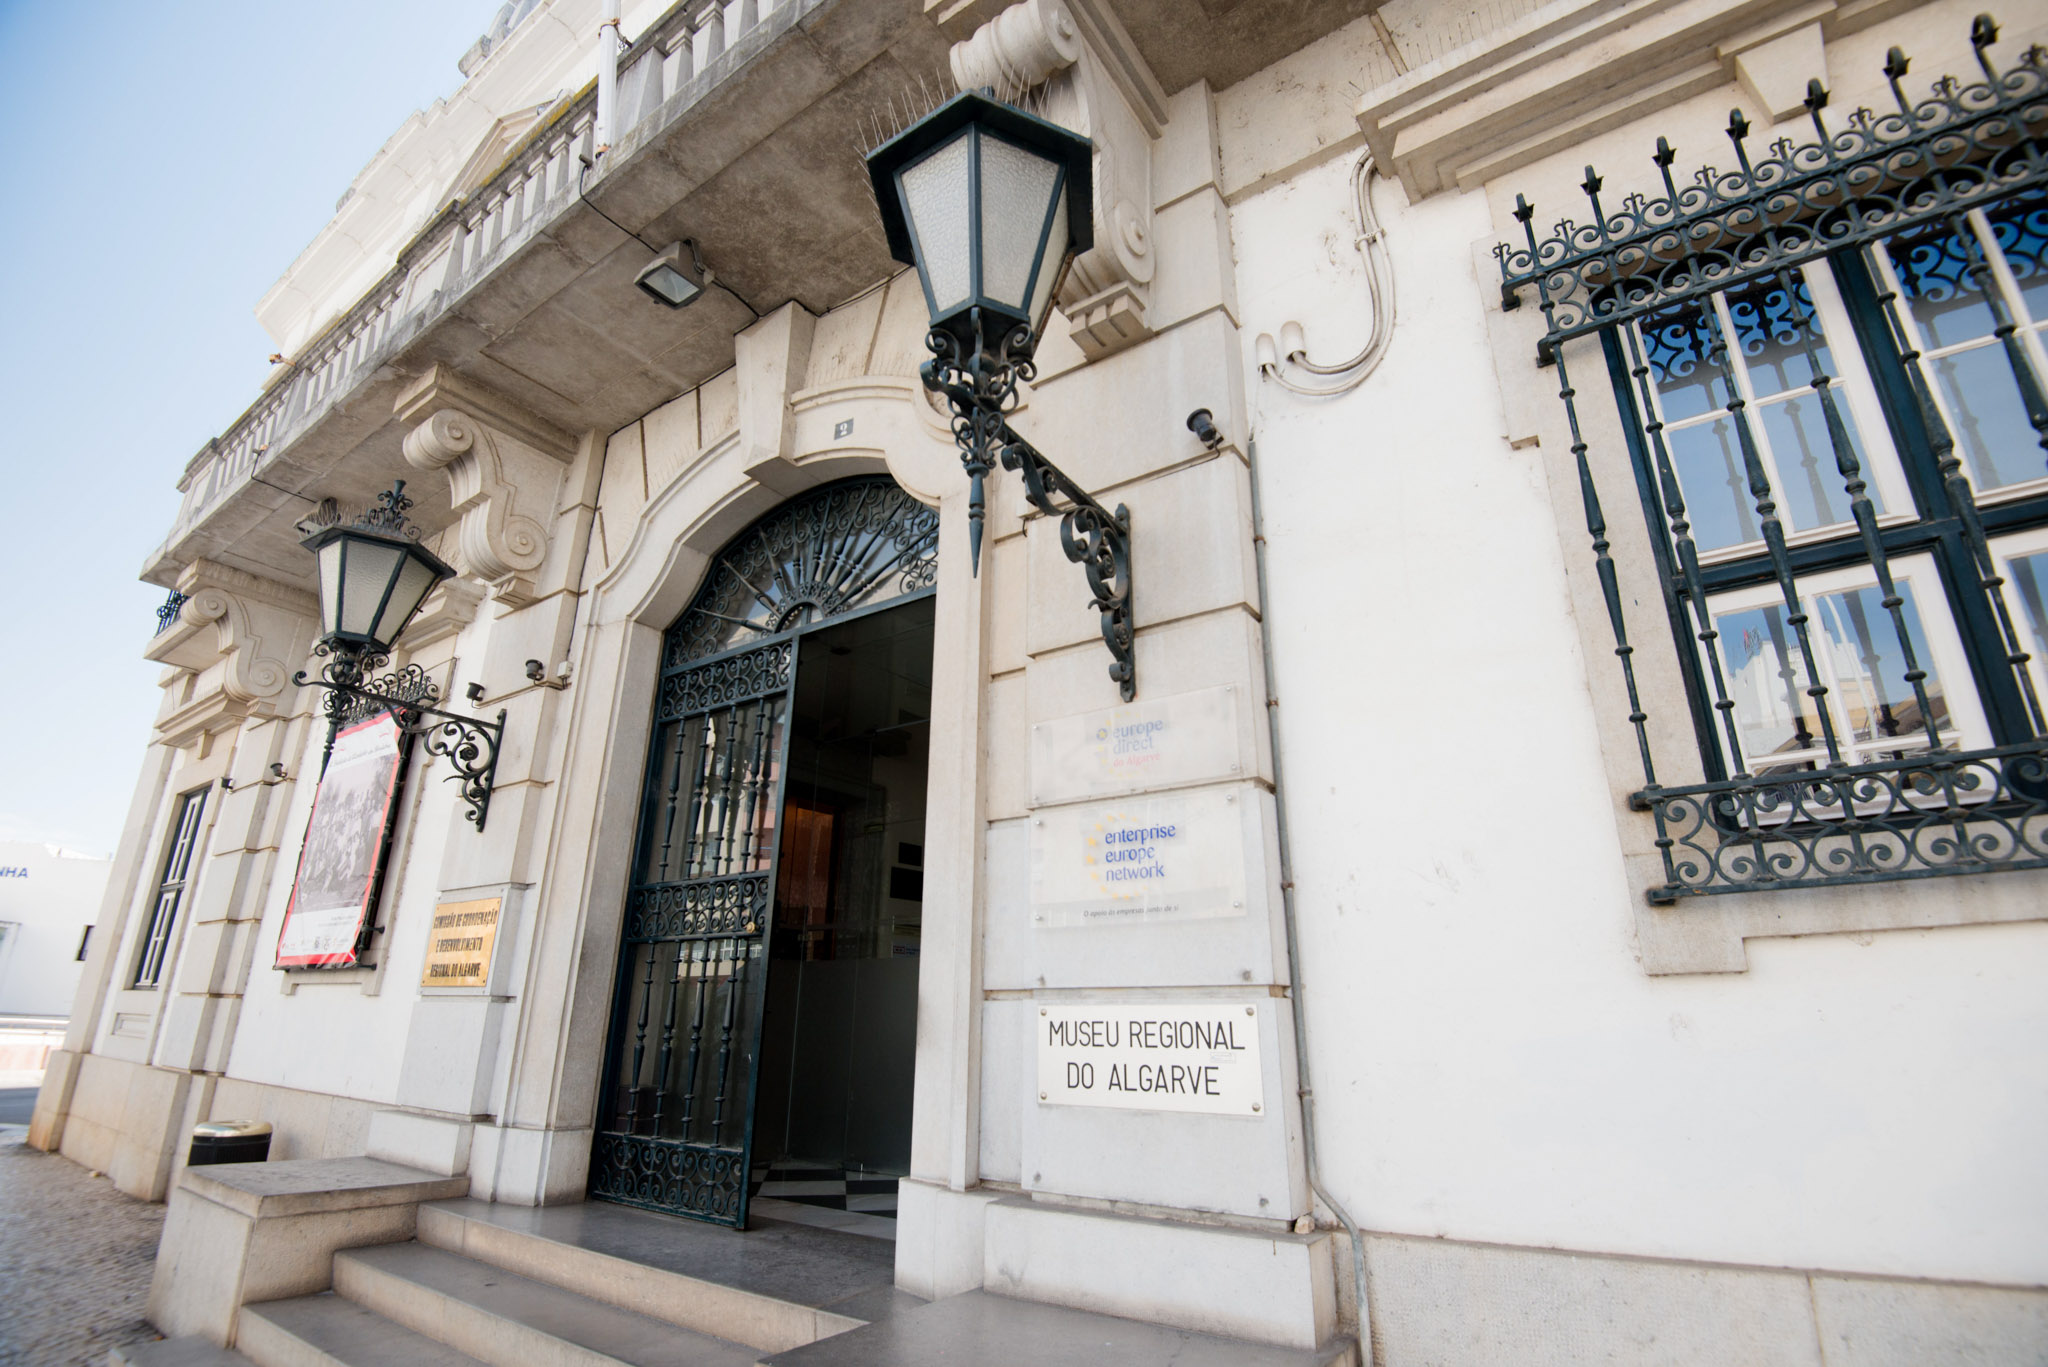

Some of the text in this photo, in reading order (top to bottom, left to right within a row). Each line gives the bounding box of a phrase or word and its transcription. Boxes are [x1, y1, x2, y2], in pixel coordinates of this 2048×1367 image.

[840, 422, 848, 437] 2
[1113, 719, 1163, 739] europe
[1113, 736, 1153, 755] direct
[1127, 752, 1161, 767] Algarve
[1105, 824, 1176, 845] enterprise
[1105, 846, 1155, 866] europe
[1106, 861, 1165, 882] network
[456, 913, 463, 927] DE
[430, 962, 481, 977] REGIONAL DO ALGARVE
[1049, 1020, 1245, 1050] MUSEU REGIONAL
[1067, 1062, 1220, 1096] DO ALGARVE
